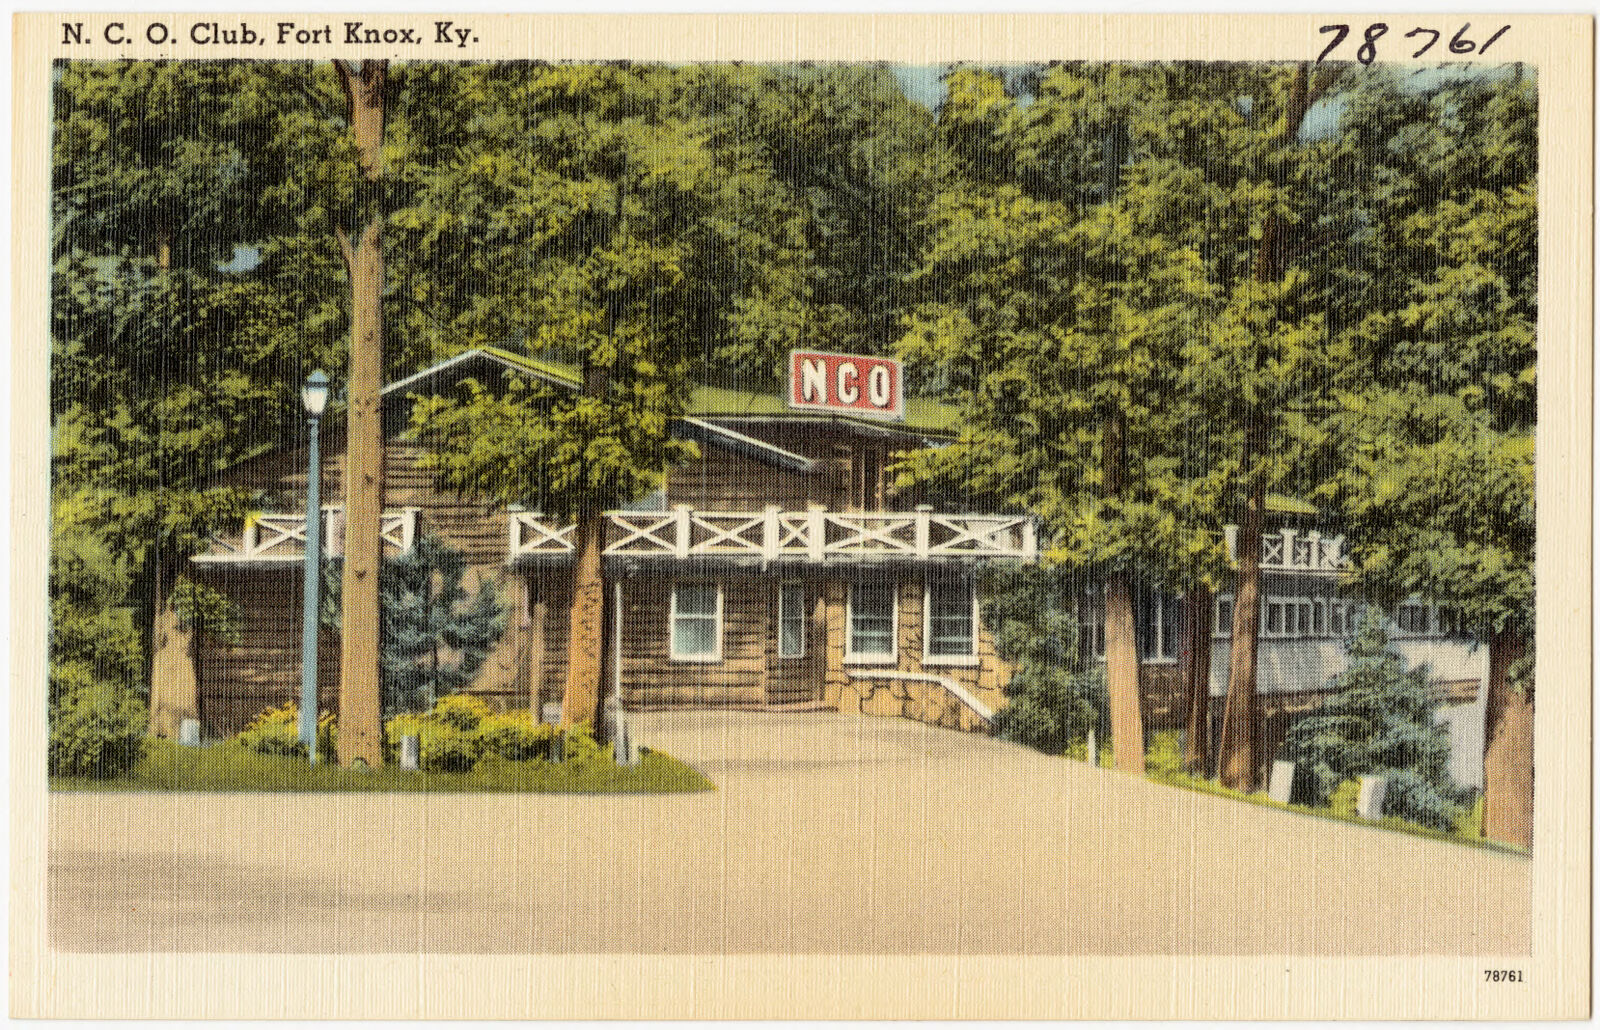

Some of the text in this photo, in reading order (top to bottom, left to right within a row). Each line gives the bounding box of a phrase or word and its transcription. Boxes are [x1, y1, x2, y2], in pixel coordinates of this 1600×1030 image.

[61, 21, 480, 48] N. C. O. Club, Fort Knox, Ky.
[801, 358, 891, 408] NCO
[1484, 970, 1523, 982] 78761
